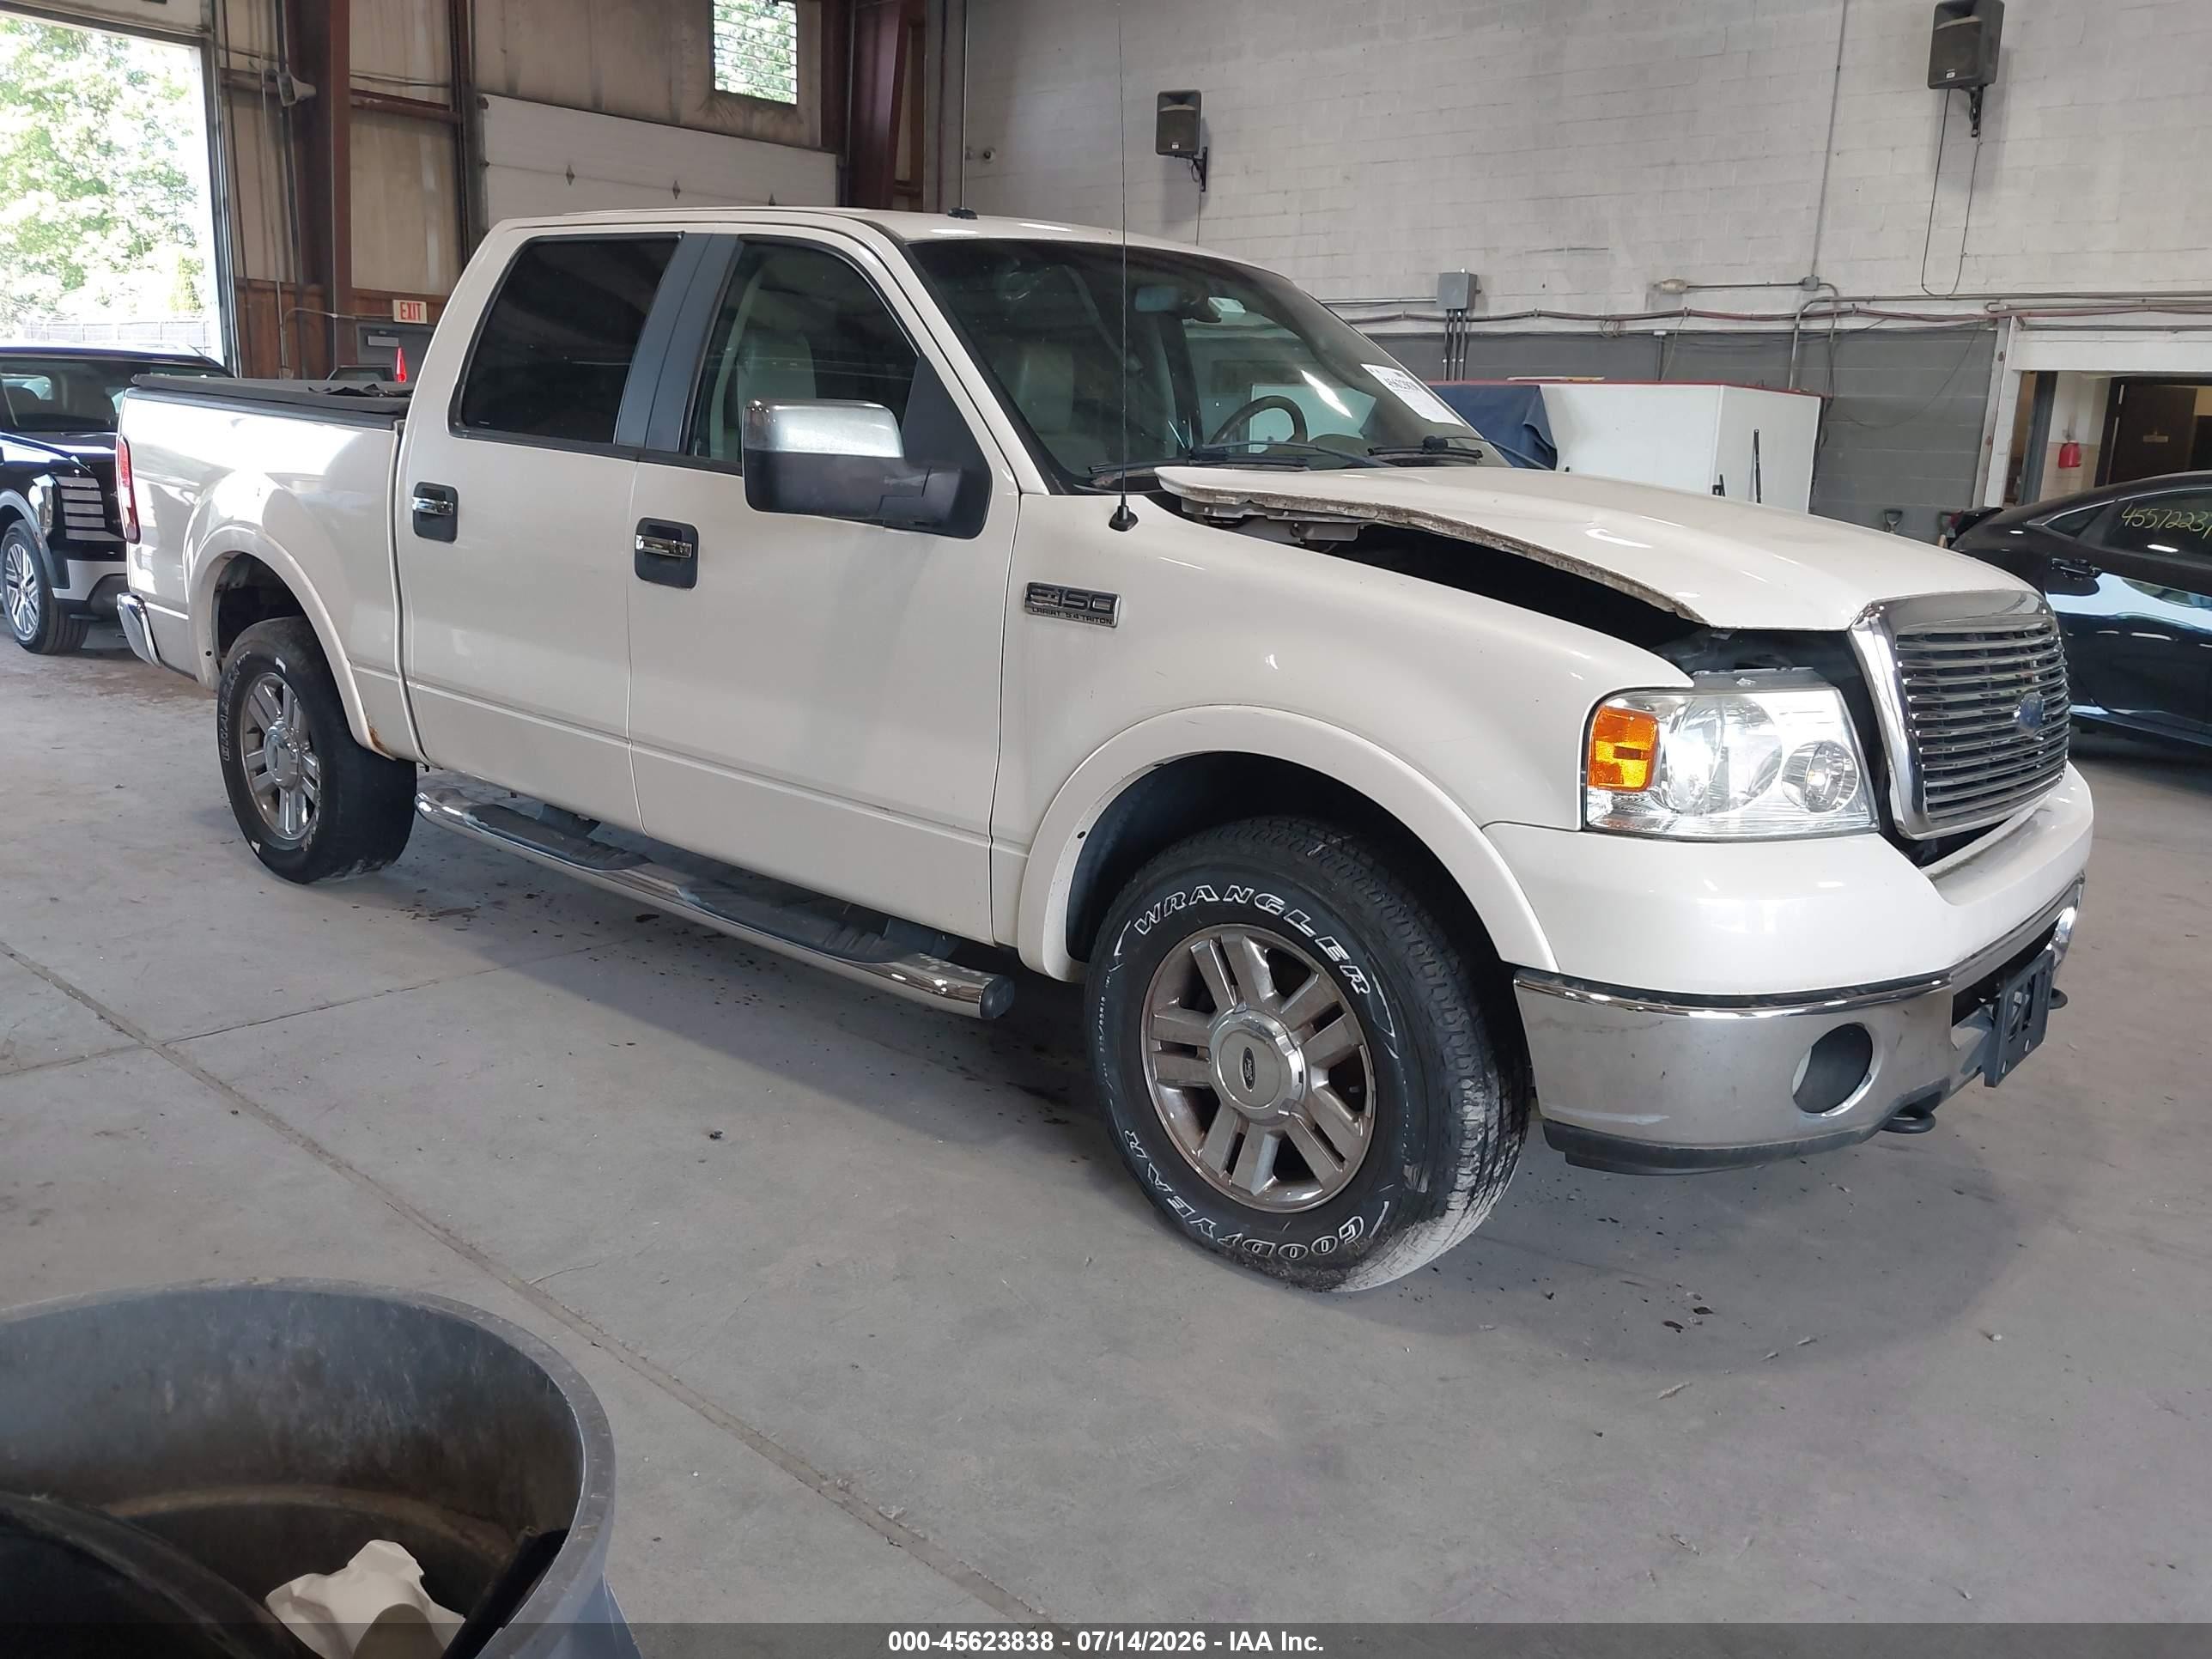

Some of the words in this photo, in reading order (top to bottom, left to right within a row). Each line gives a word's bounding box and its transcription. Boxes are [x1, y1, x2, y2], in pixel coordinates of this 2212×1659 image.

[399, 301, 422, 320] EXIT
[1032, 606, 1060, 617] LARIAT
[1080, 614, 1113, 626] TRITON
[1134, 884, 1371, 994] WRANGLER
[1125, 1129, 1364, 1261] GOODYEAR
